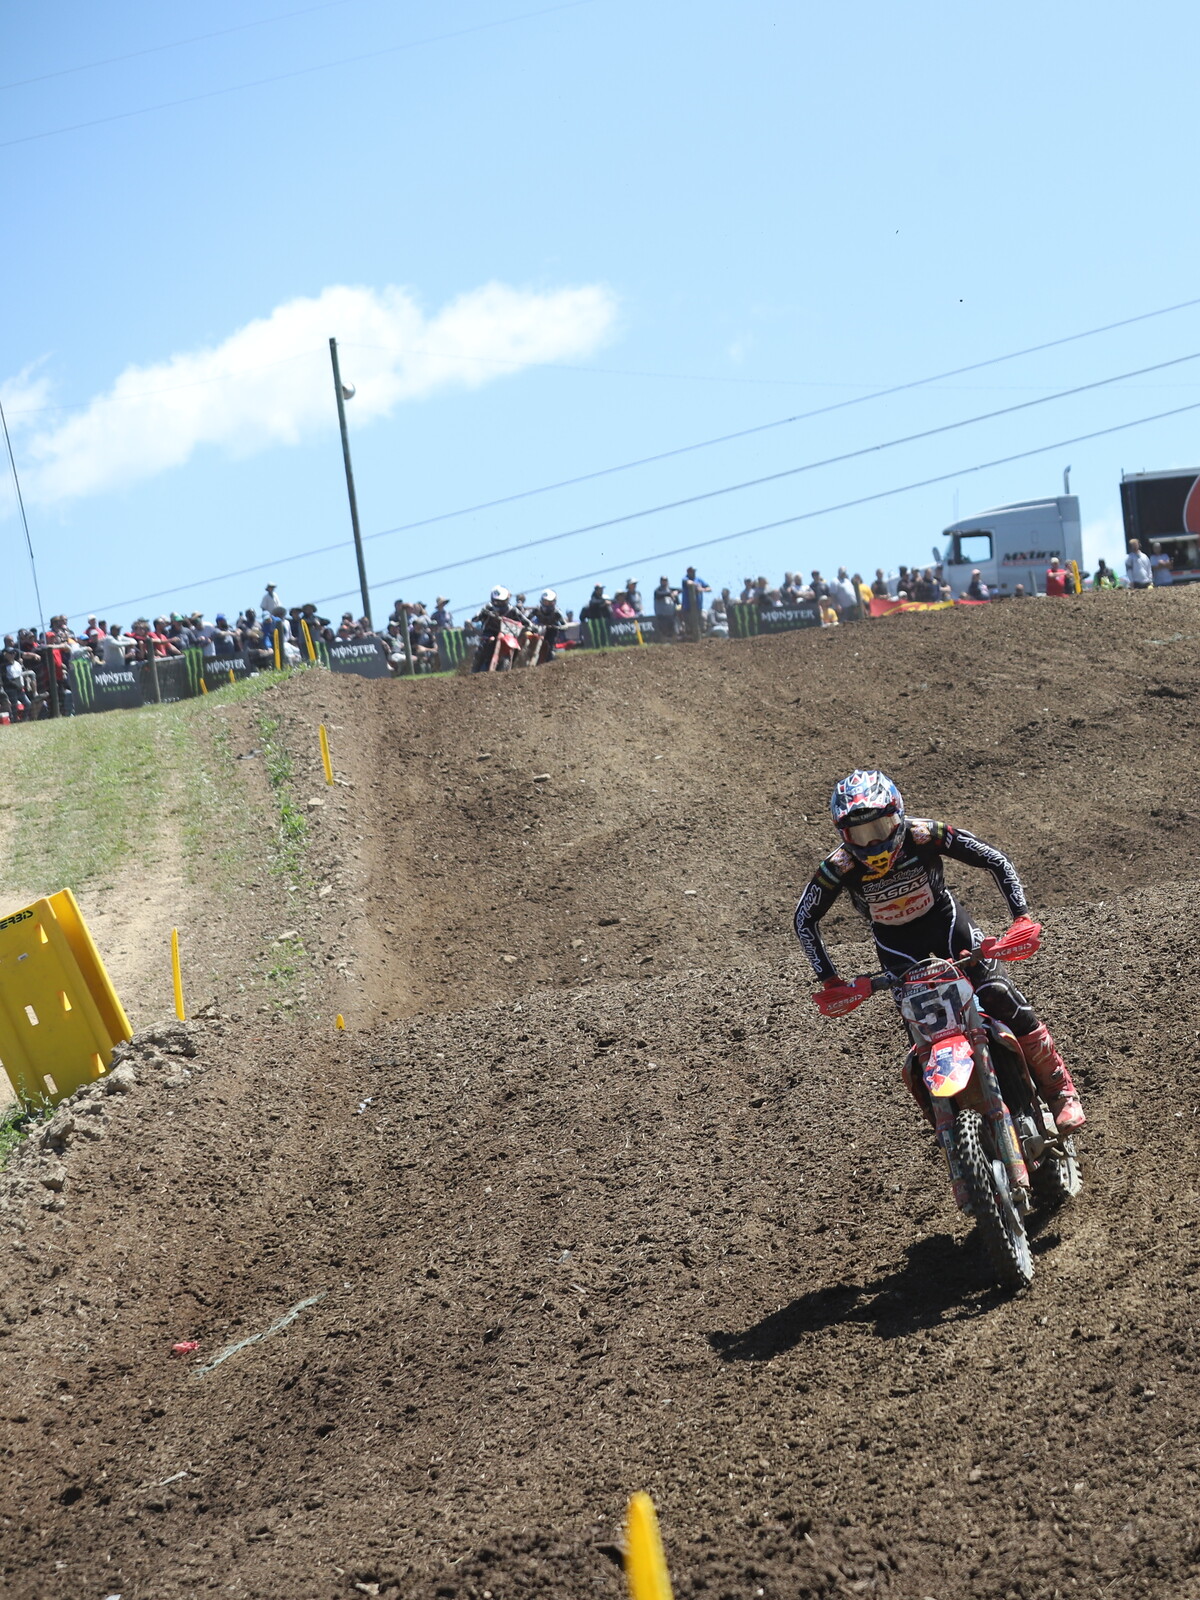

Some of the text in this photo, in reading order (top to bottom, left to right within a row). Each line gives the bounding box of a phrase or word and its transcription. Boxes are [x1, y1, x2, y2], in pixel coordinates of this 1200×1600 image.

[331, 643, 377, 659] MONSTER
[206, 658, 247, 674] MONSTER
[95, 671, 135, 686] MONSTER
[865, 876, 928, 902] GASGAS
[0, 910, 33, 930] ERBIS
[910, 983, 964, 1035] 51
